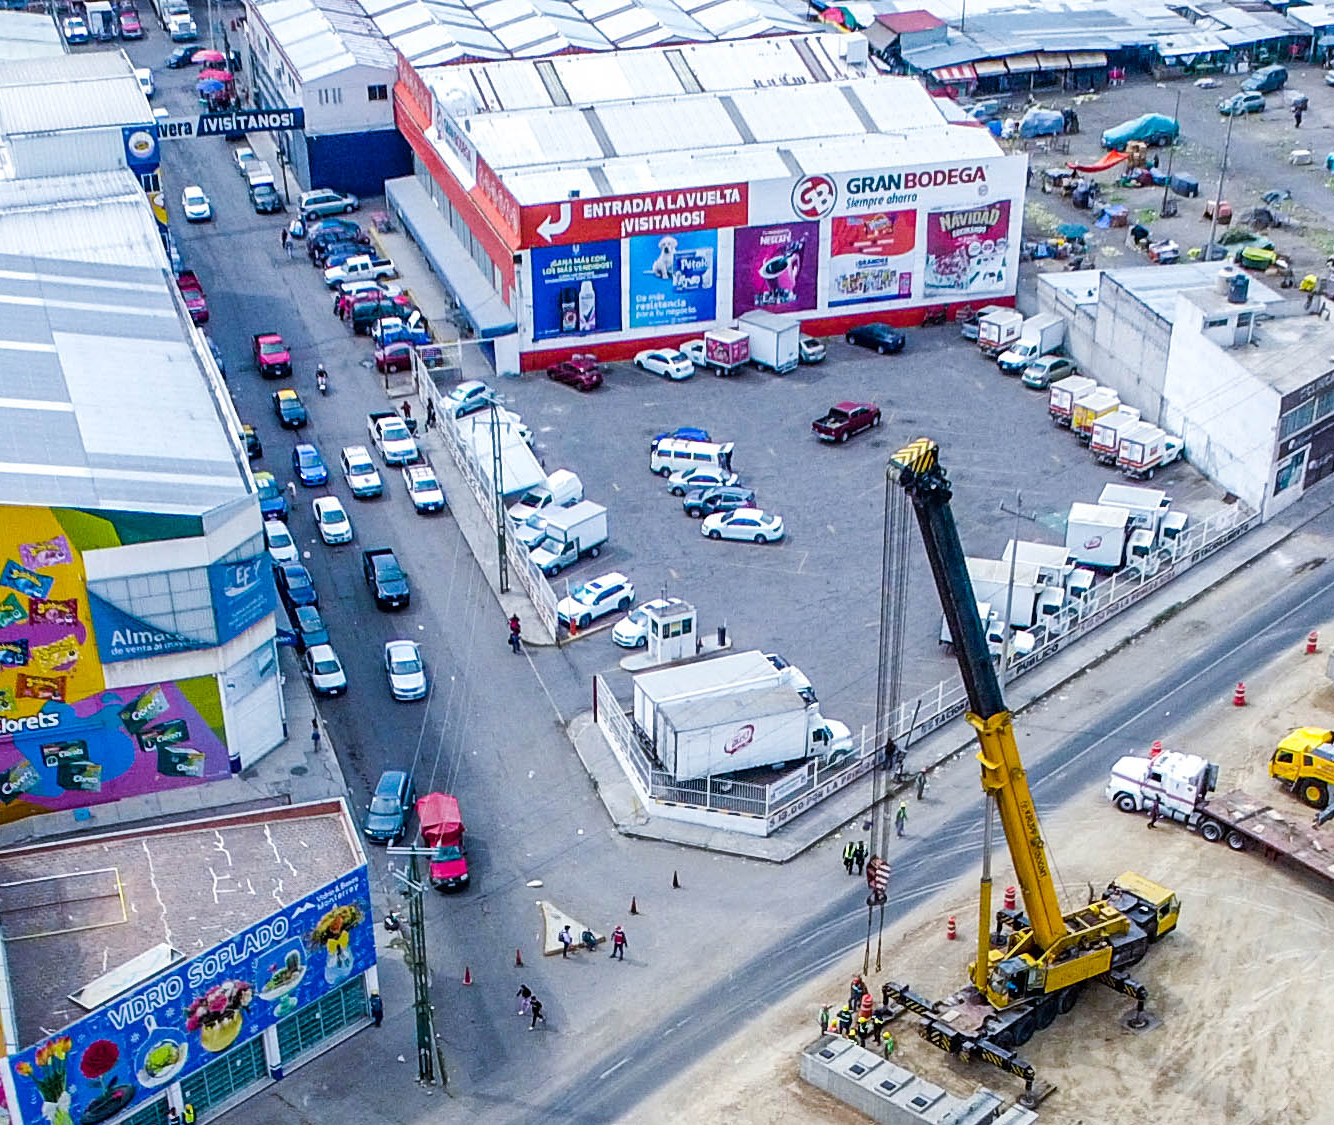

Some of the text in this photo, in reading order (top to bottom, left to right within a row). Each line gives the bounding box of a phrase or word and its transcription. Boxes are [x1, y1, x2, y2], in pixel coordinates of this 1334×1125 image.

[846, 166, 986, 195] GRAN BODEGA
[583, 198, 653, 219] ENTRADA
[655, 197, 665, 211] A
[846, 194, 885, 210] Siempre
[939, 207, 1000, 232] NAVIDAD
[107, 915, 289, 1031] VIDRIO SOPLADO
